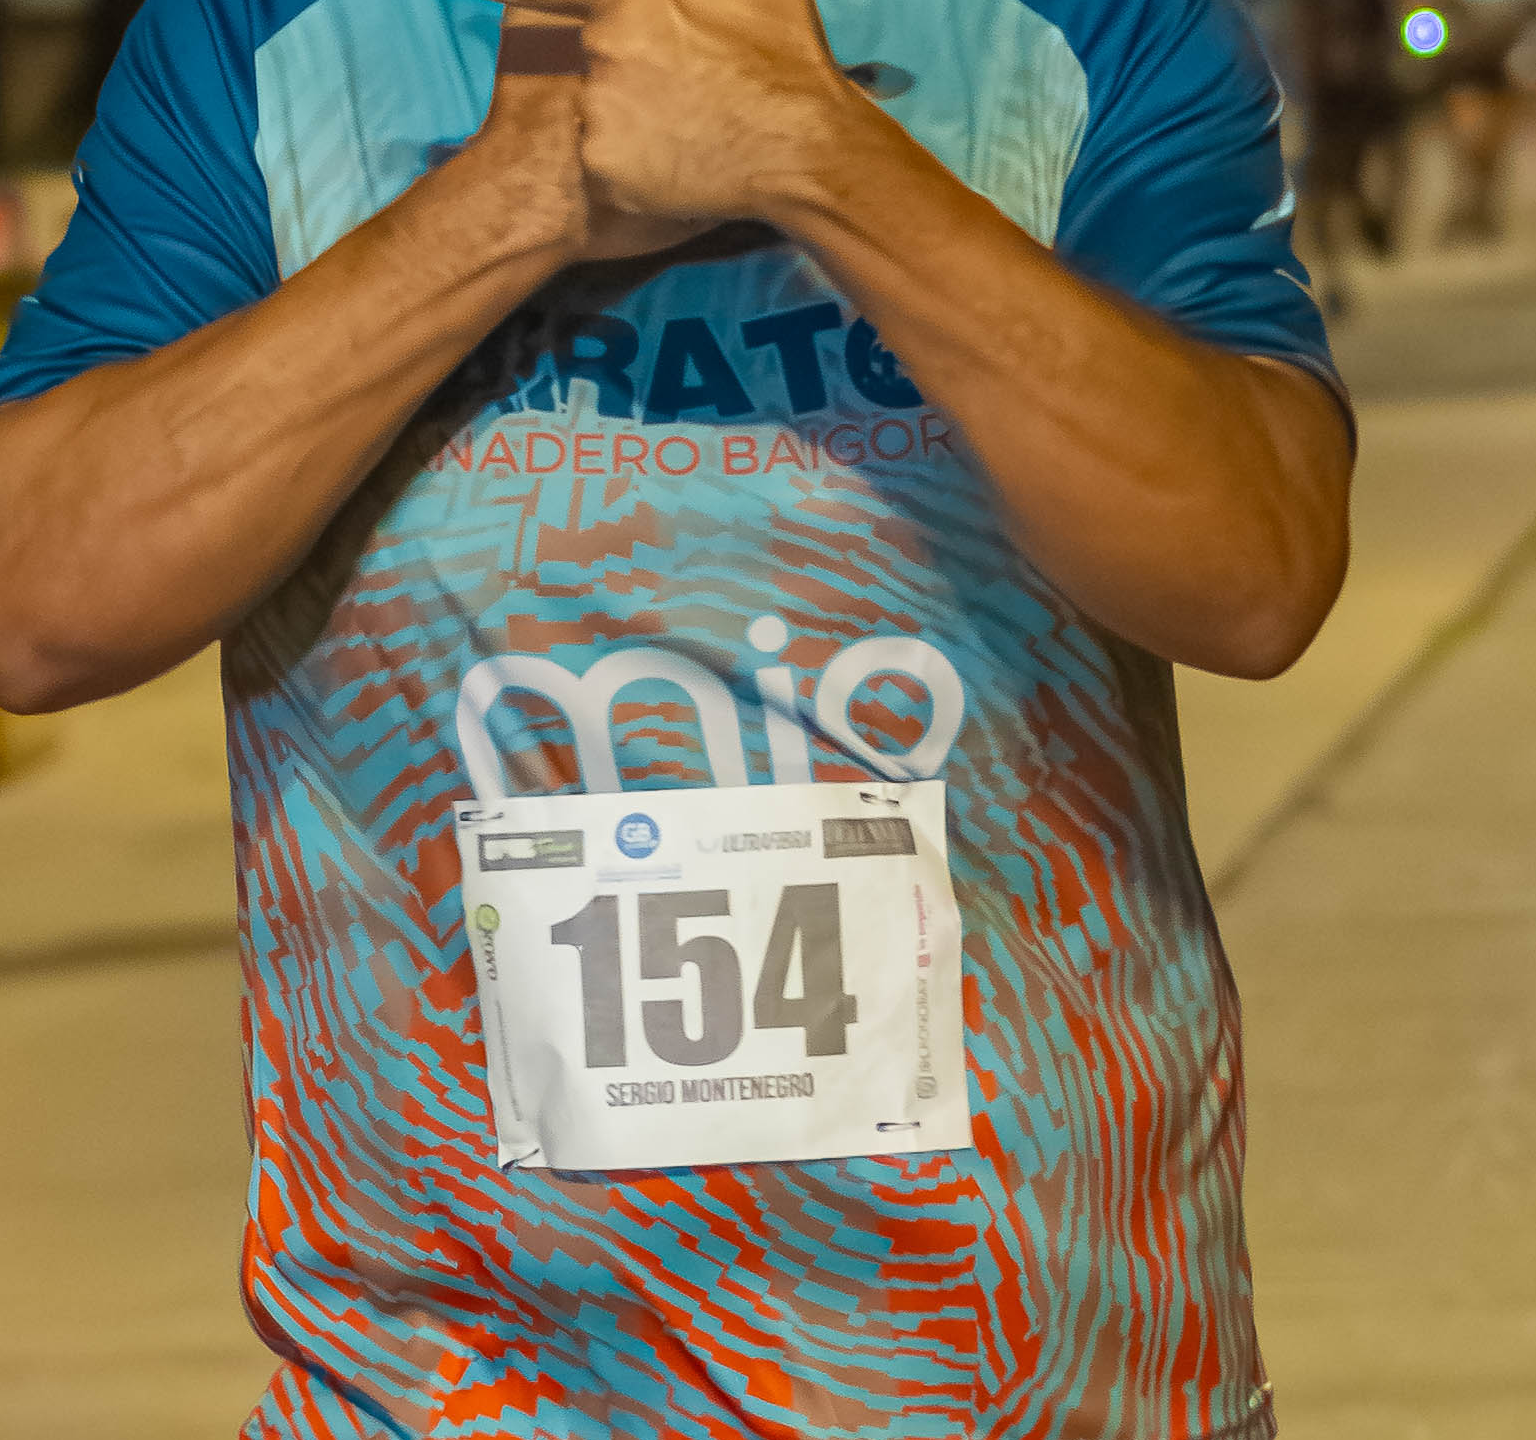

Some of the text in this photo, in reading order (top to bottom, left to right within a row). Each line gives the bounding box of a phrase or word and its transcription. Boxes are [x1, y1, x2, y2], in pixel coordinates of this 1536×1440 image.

[500, 301, 926, 426] RATO
[426, 414, 955, 476] NADERO BAIGOR
[456, 614, 965, 795] mio
[550, 882, 859, 1069] 154
[606, 1072, 815, 1107] SERGIO MONTENEGRO
